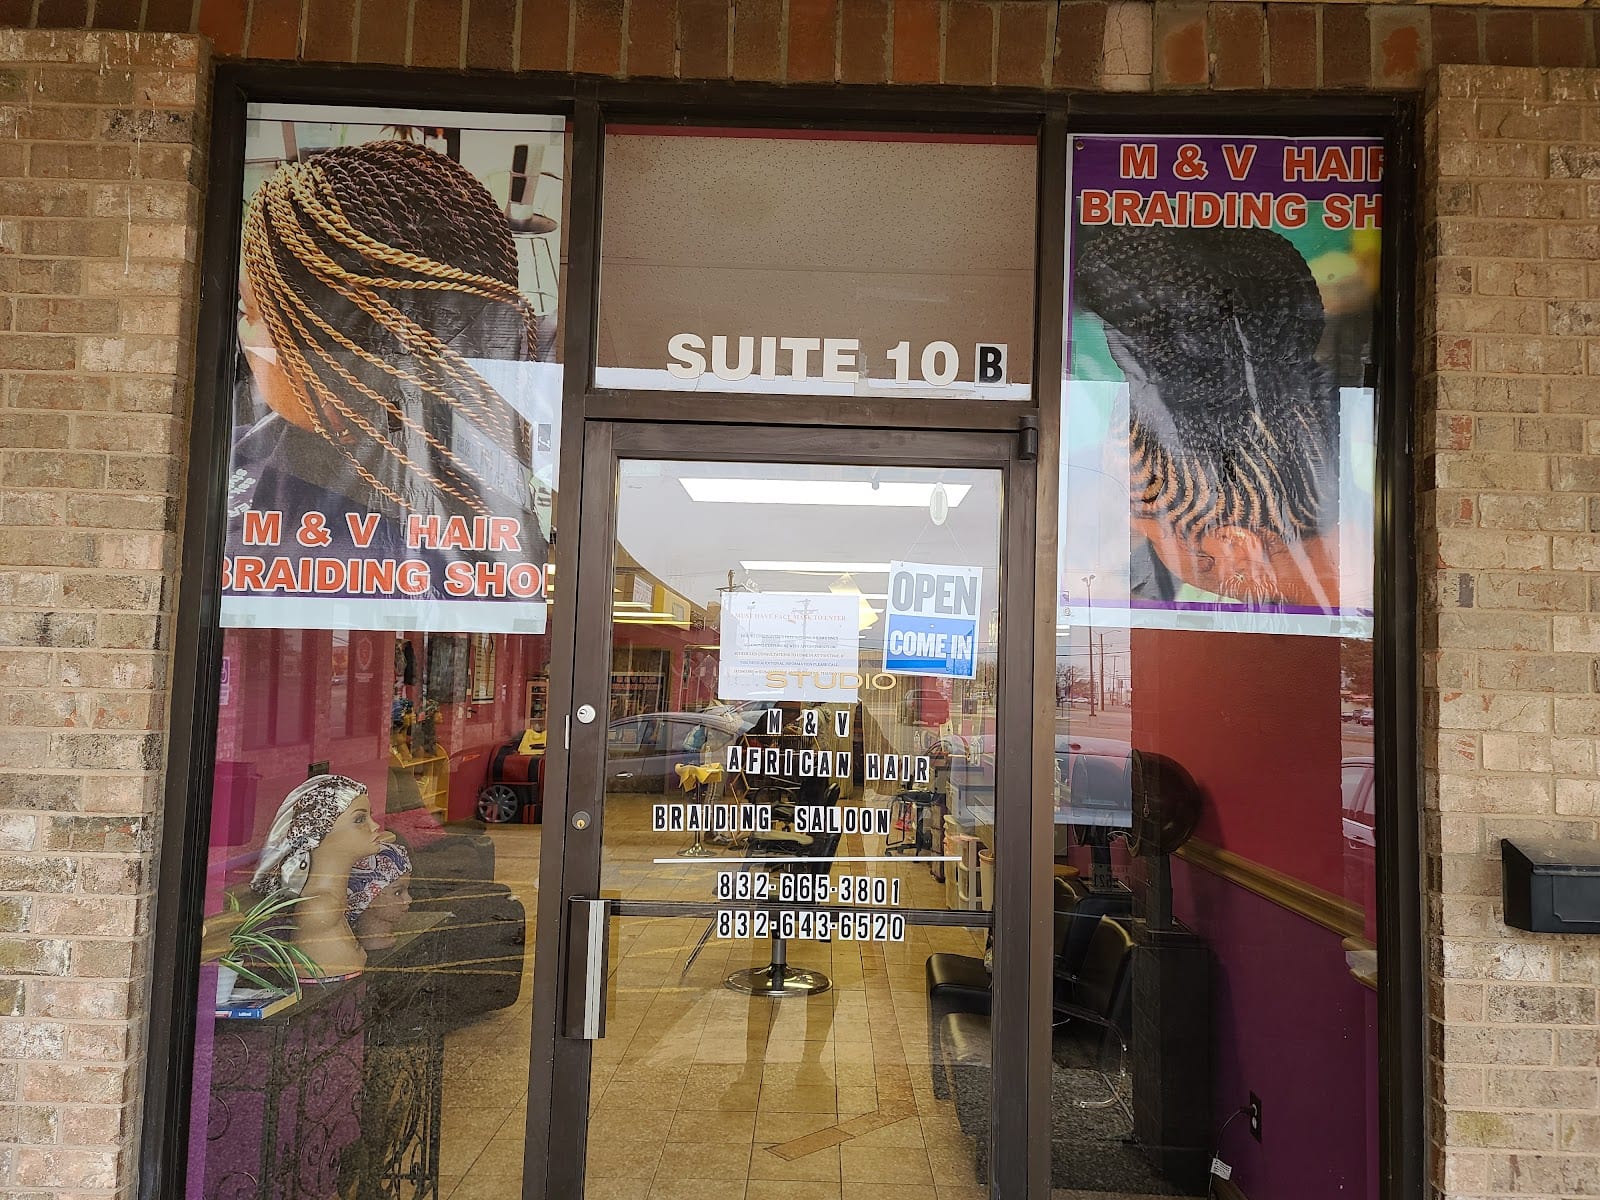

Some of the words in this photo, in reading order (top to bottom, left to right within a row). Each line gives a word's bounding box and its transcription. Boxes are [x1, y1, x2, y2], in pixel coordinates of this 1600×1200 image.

[1120, 144, 1157, 179] M
[1173, 144, 1209, 180] &
[1222, 145, 1257, 181] V
[1080, 189, 1308, 229] BRAIDING
[666, 333, 861, 383] SUITE
[243, 510, 283, 546] M
[296, 511, 331, 547] &
[346, 512, 381, 547] V
[406, 514, 521, 551] HAIR
[444, 560, 548, 598] SHO
[892, 570, 978, 616] OPEN
[889, 629, 948, 659] COME
[950, 634, 973, 660] IN
[766, 671, 897, 691] STUDIO
[768, 709, 781, 734] M
[803, 711, 817, 736] &
[837, 711, 849, 737] V
[728, 747, 850, 777] AFRICAN
[867, 754, 929, 782] HAIR
[654, 805, 771, 831] BRAIDING
[795, 806, 890, 834] SALOON
